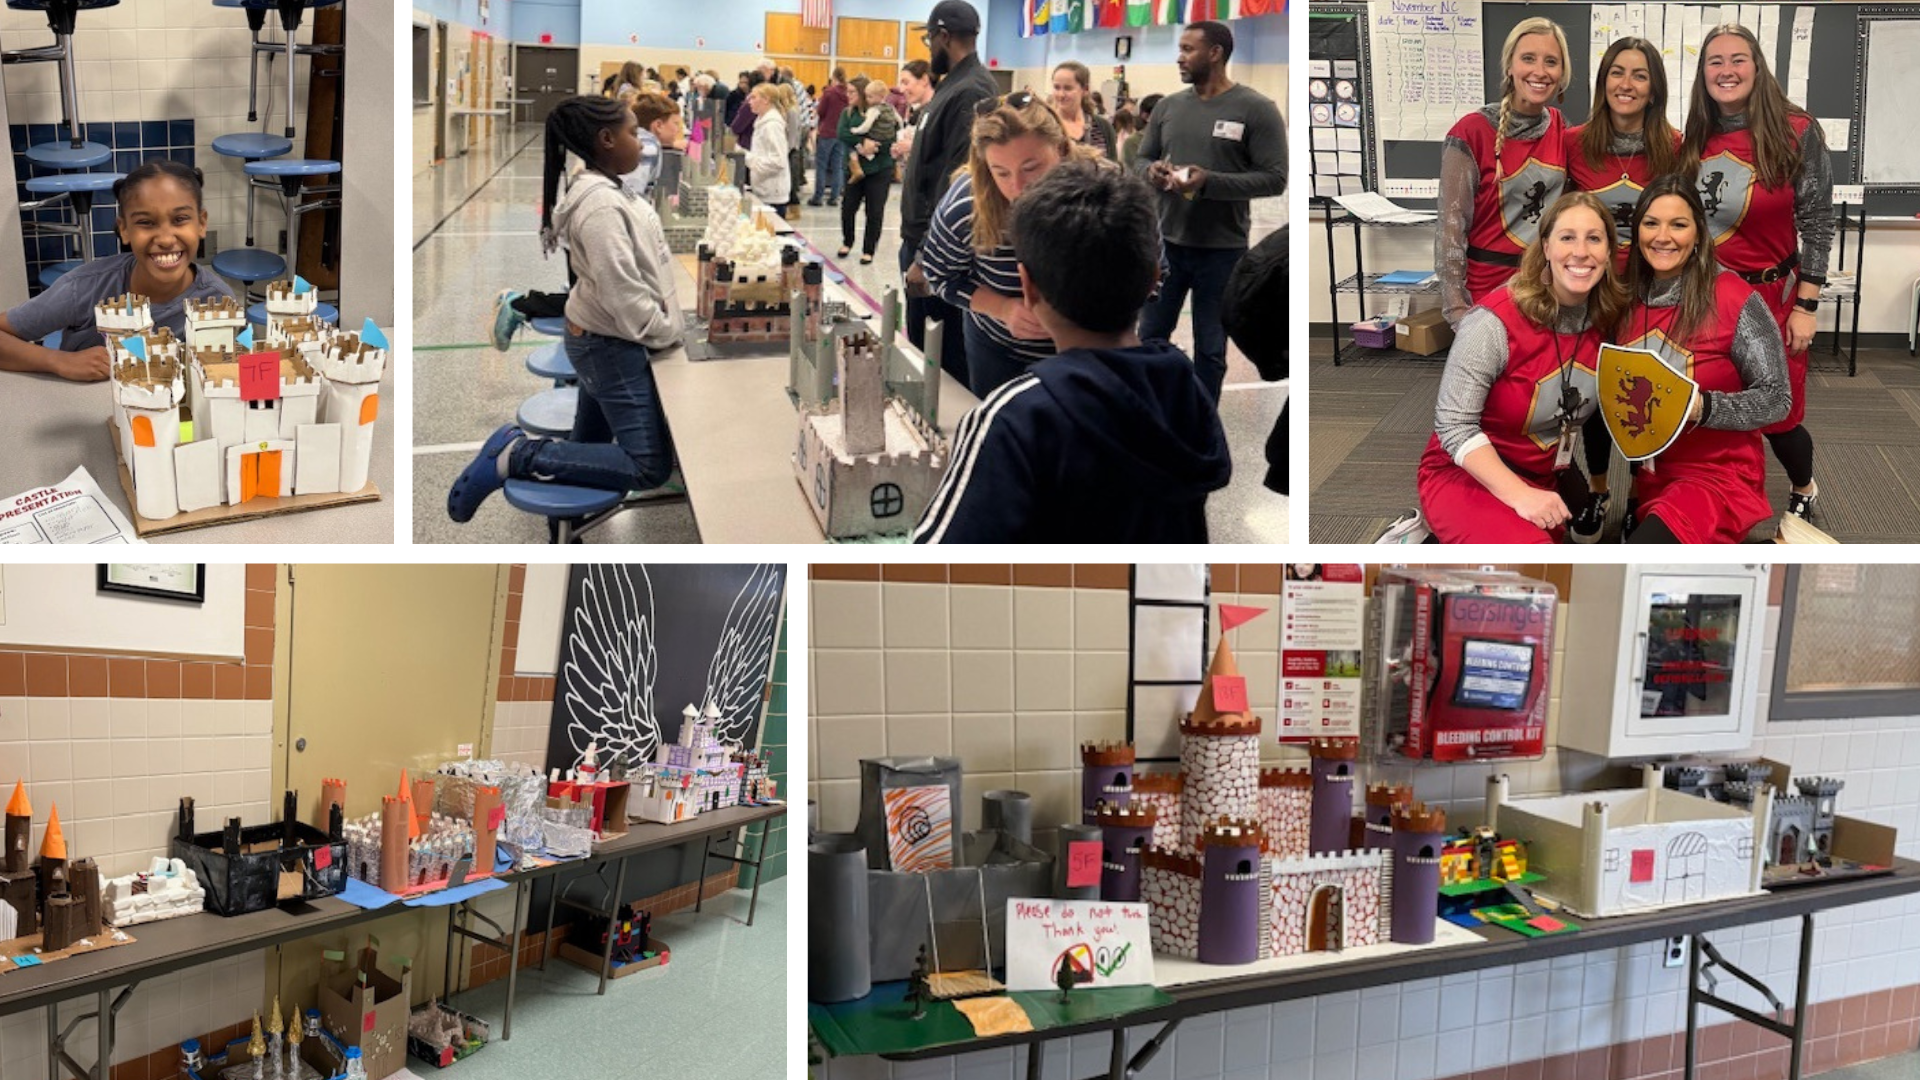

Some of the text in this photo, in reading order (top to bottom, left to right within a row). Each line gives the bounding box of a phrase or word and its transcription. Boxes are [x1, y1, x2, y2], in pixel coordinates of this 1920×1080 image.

[1392, 0, 1437, 12] November
[1632, 9, 1639, 17] T
[1378, 15, 1395, 26] date
[1402, 15, 1420, 26] time
[0, 489, 83, 521] PRESENTATION
[15, 488, 58, 506] CASTLE
[1451, 597, 1550, 631] Geisinger
[1408, 595, 1429, 750] BLEEDING CONTROL KIT
[1436, 726, 1542, 746] BLEEDING CONTROL KIT
[1072, 852, 1098, 872] 5F
[1015, 902, 1051, 921] Please
[1060, 902, 1075, 920] do
[1089, 905, 1113, 919] not
[1042, 922, 1085, 939] Thank
[19, 956, 33, 965] 4
